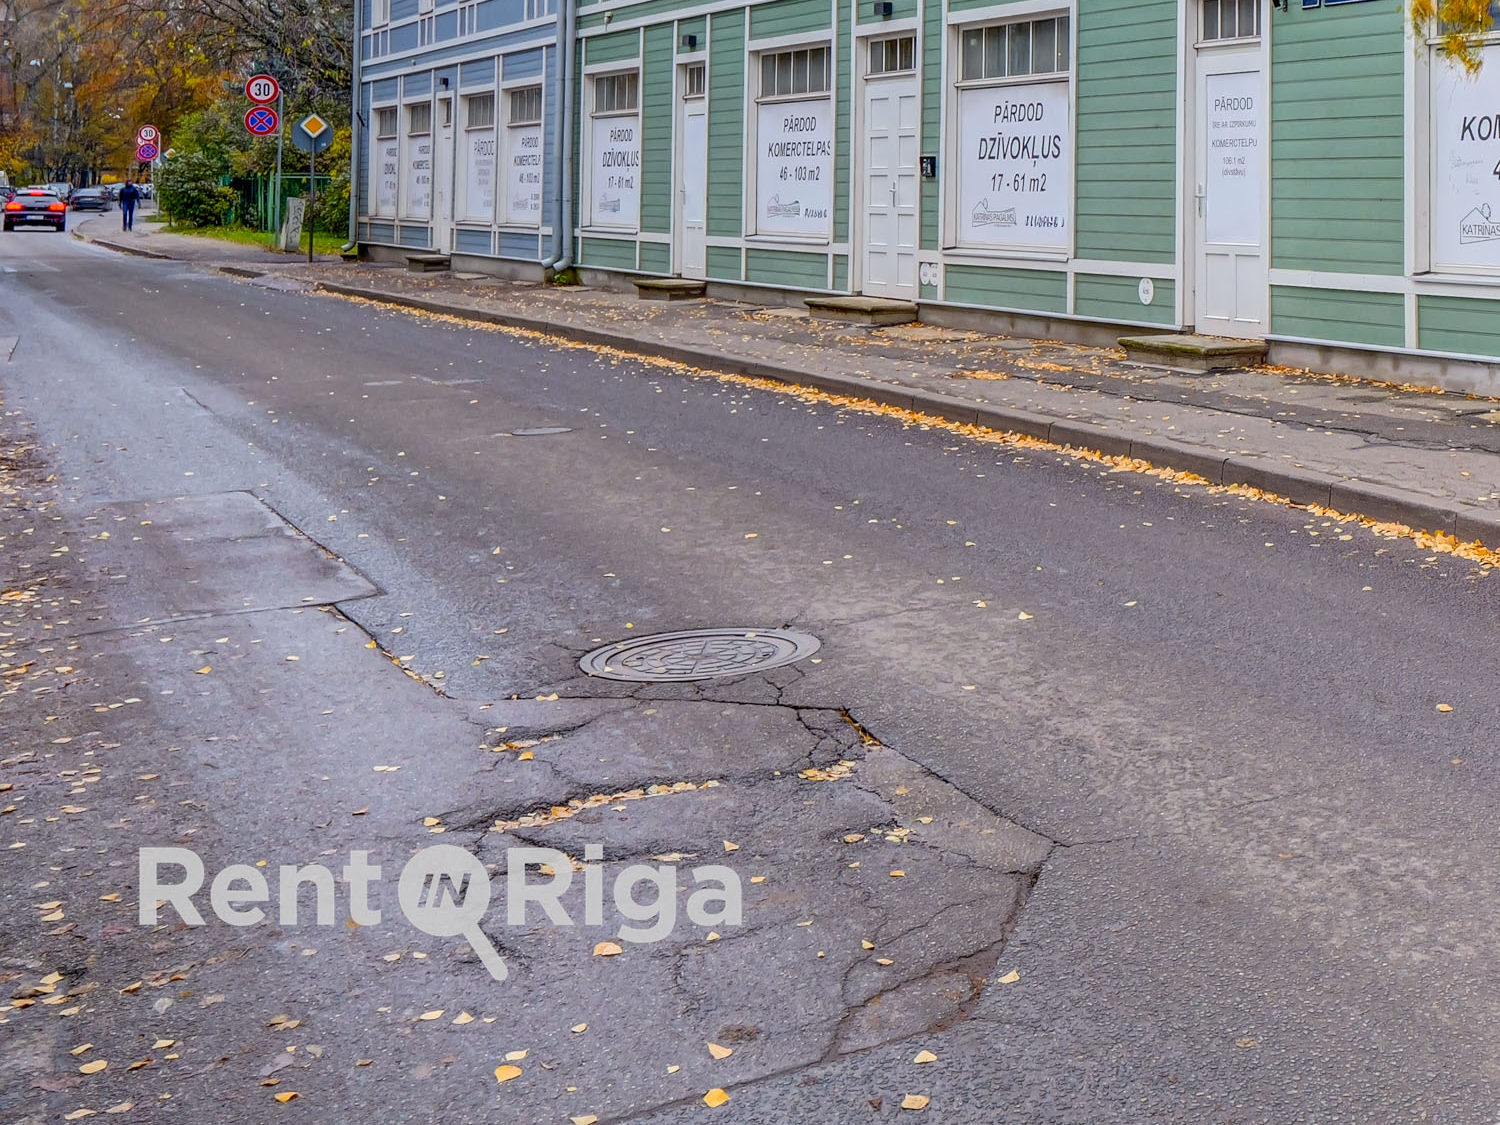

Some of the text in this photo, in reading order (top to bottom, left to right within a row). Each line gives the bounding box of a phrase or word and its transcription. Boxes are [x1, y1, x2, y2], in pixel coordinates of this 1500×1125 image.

[254, 82, 270, 96] 30
[1214, 96, 1253, 111] PĀRDOD
[994, 101, 1044, 123] PĀRDOD
[783, 115, 816, 132] PĀRDOD
[143, 129, 153, 137] 30
[610, 127, 633, 142] PĀRDOD
[978, 132, 1061, 167] DZĪVOKĻUS
[1211, 138, 1257, 148] KOMERCTELPU
[780, 166, 788, 181] 46
[794, 166, 807, 181] 103
[808, 166, 820, 181] m2
[608, 176, 614, 188] 17
[992, 173, 1004, 192] 17
[1013, 173, 1026, 192] 61
[1029, 173, 1046, 192] m2
[1462, 222, 1500, 236] KATRĪNAS
